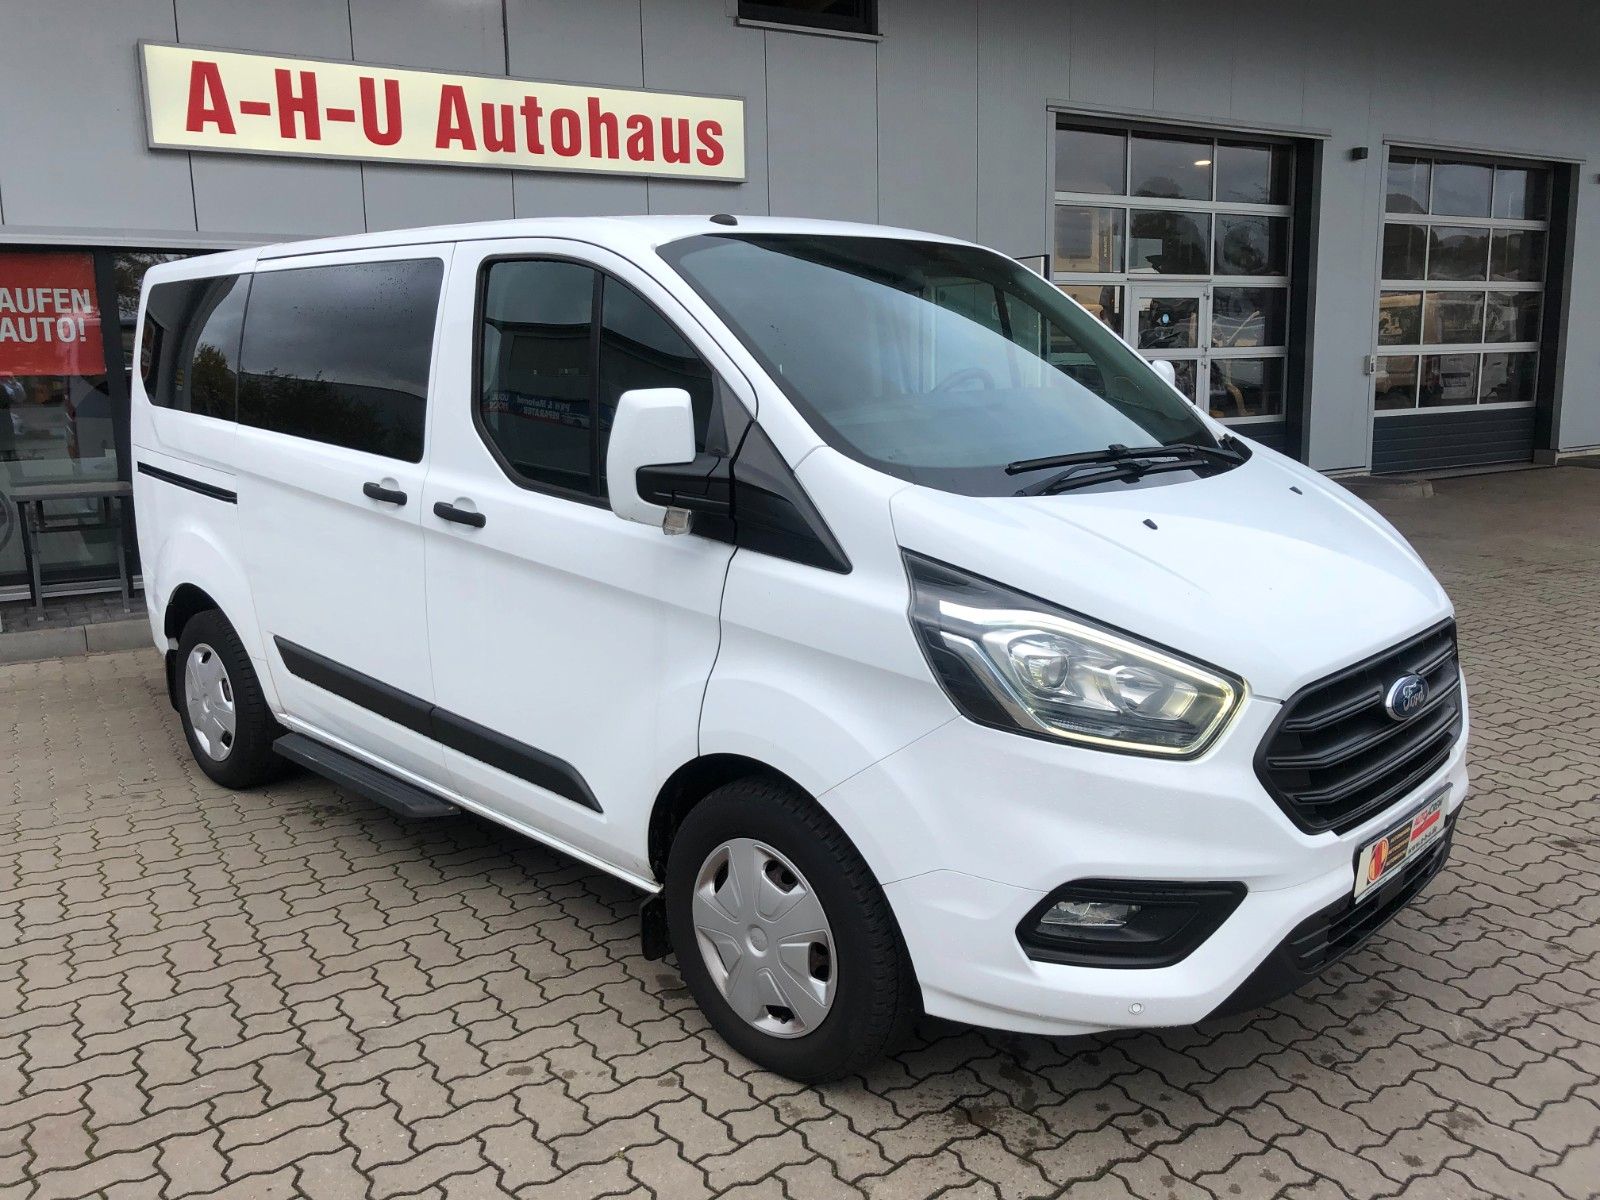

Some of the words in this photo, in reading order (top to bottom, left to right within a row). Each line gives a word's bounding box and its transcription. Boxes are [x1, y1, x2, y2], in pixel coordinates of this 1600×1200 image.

[186, 61, 402, 146] A-H-U
[435, 84, 725, 166] Autohaus
[0, 317, 87, 343] AUTO!
